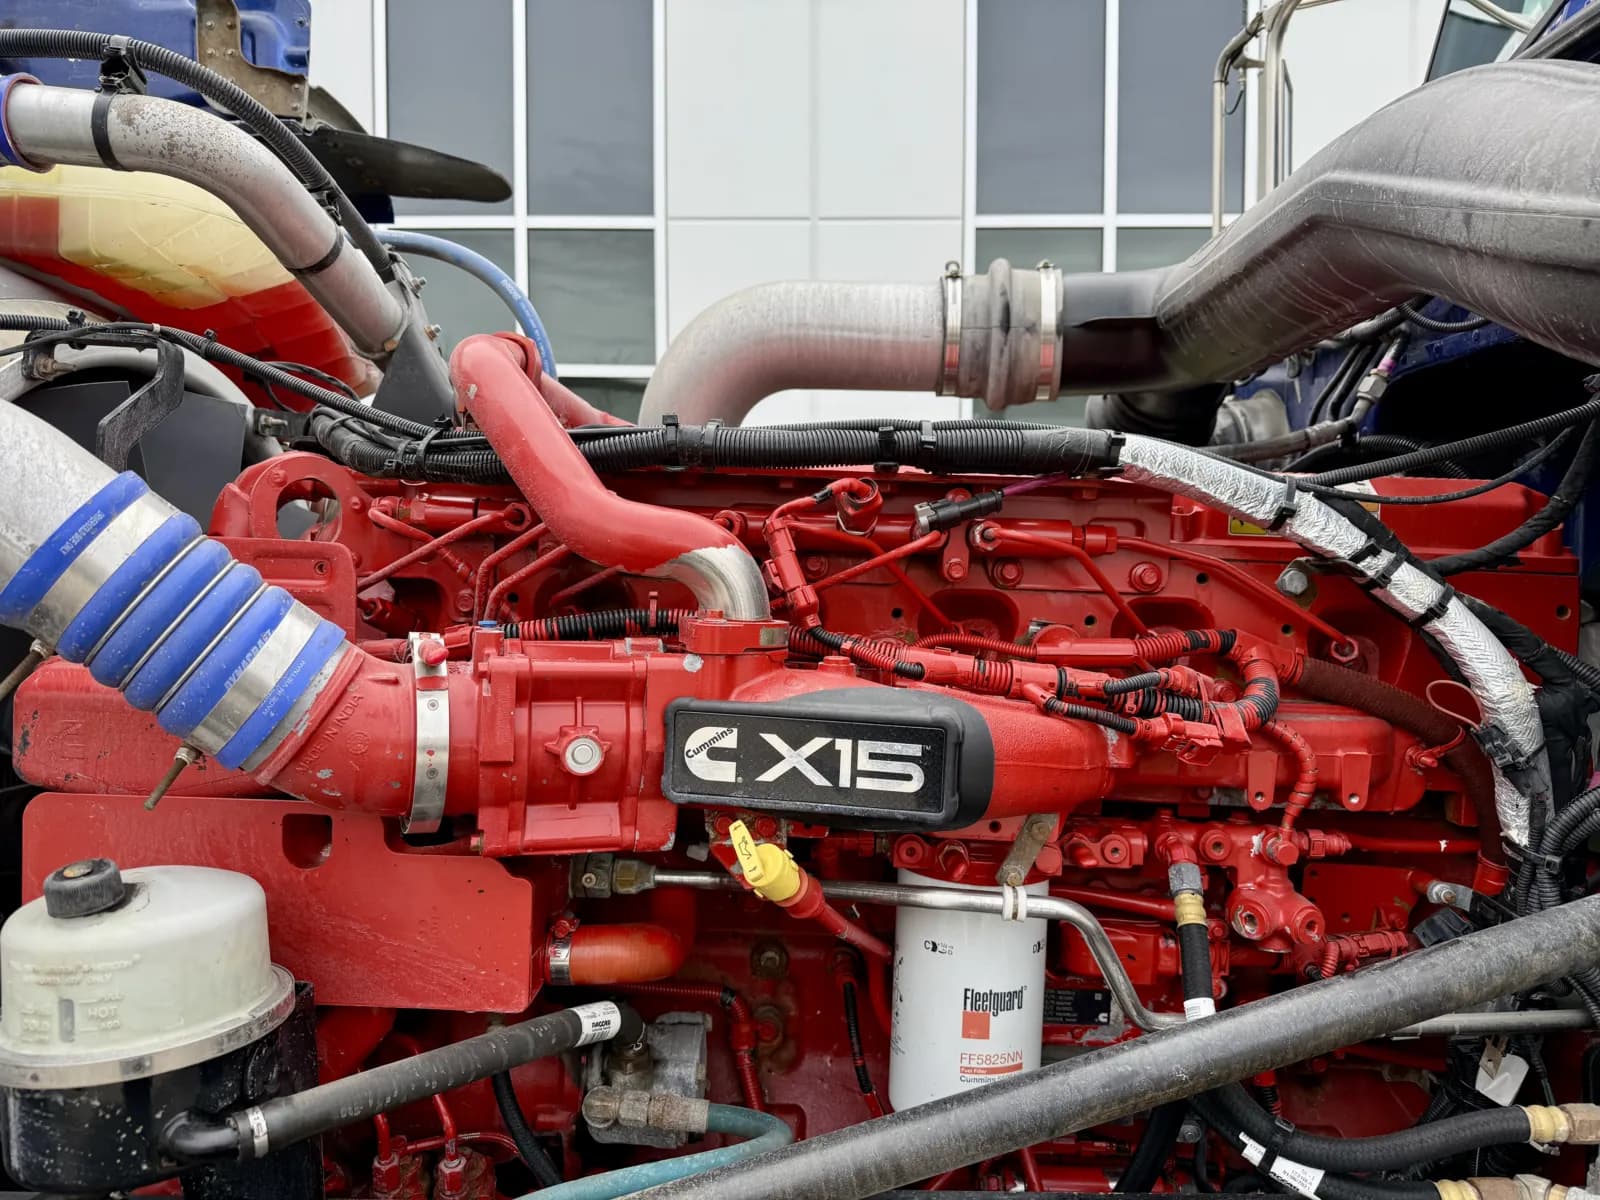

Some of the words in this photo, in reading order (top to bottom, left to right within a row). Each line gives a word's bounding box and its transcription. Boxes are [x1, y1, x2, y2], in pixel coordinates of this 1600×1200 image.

[296, 743, 327, 775] MADE
[322, 727, 338, 745] IN
[334, 695, 364, 728] INDIA
[685, 727, 734, 760] Cummins
[755, 732, 925, 793] X15
[87, 1006, 118, 1019] HOT
[963, 986, 1024, 1017] Fleetguard
[960, 1049, 1023, 1066] FF5825NN
